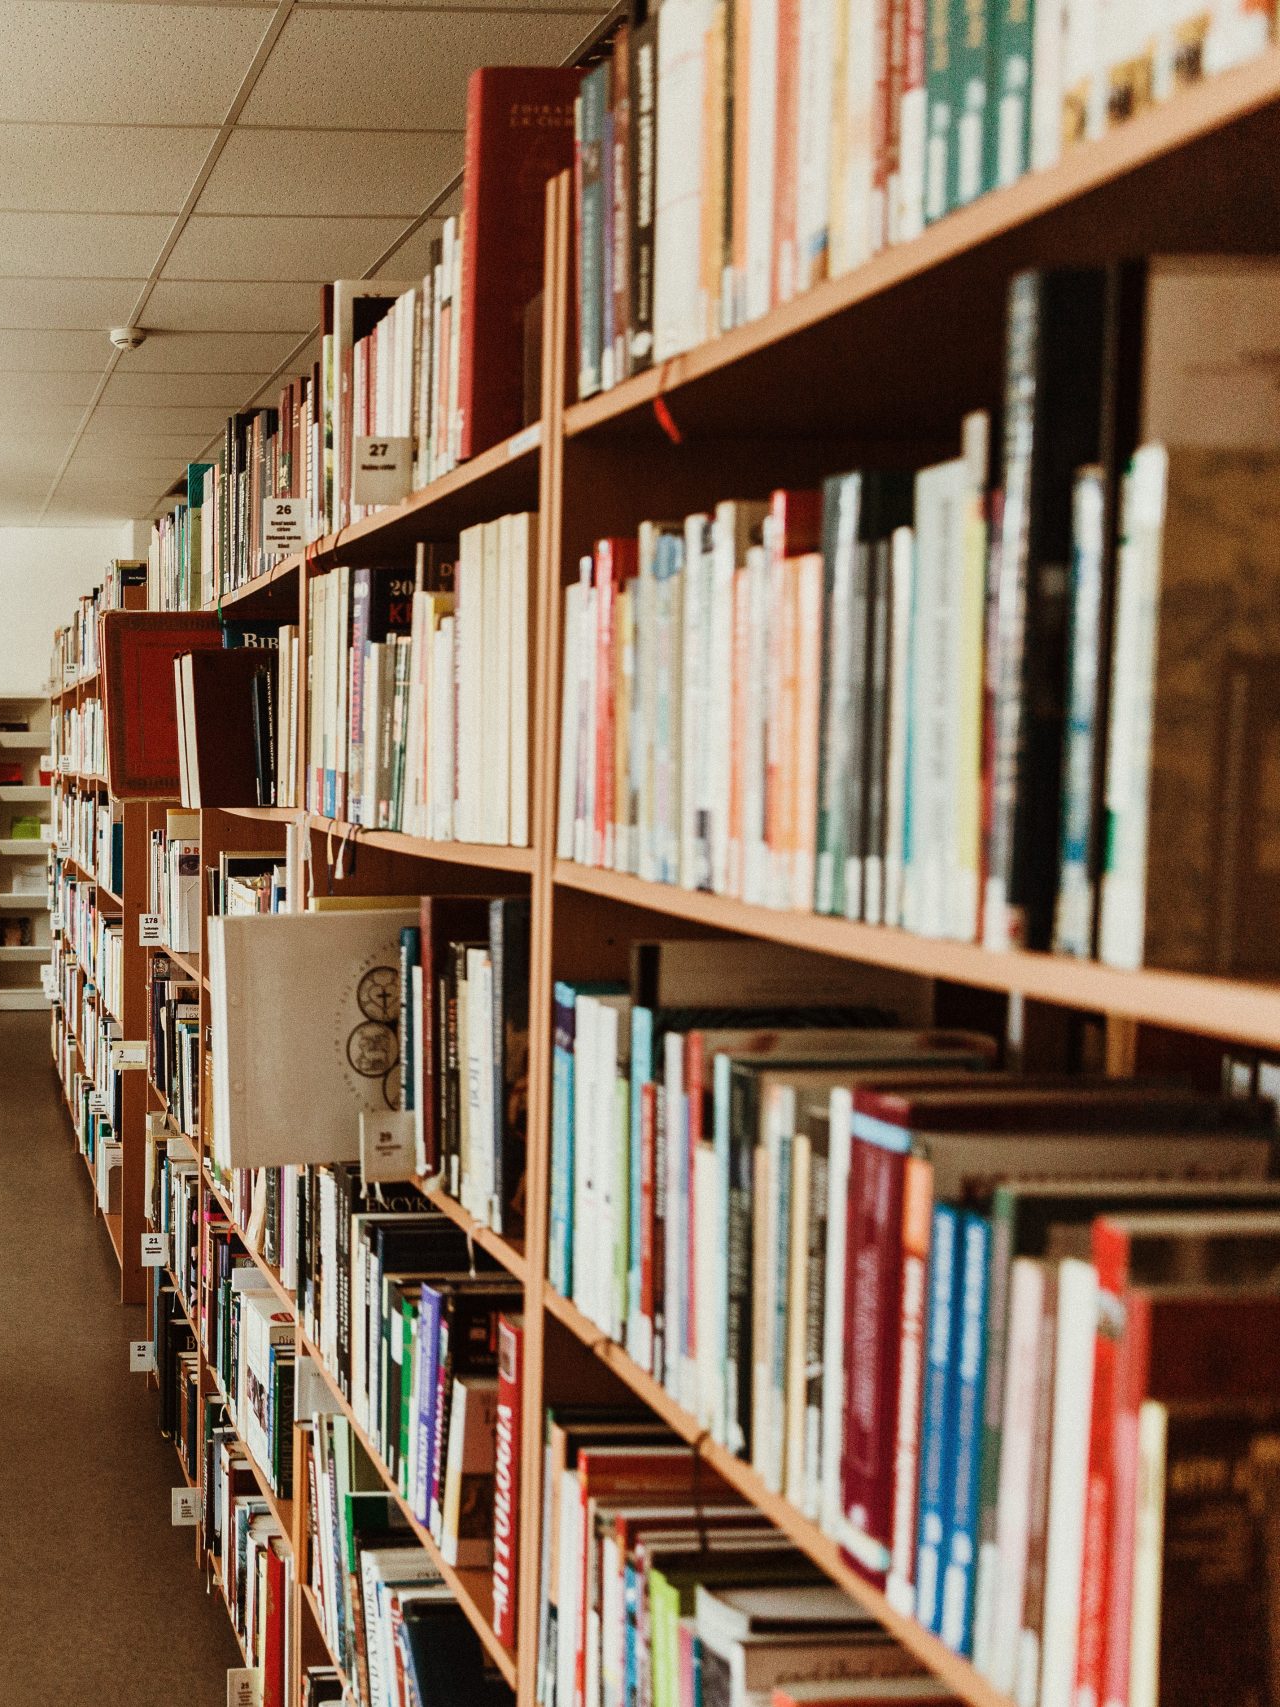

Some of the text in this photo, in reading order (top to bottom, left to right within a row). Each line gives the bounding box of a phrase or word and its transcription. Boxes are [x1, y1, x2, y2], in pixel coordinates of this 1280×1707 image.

[369, 443, 389, 457] 27
[276, 504, 292, 515] 26
[119, 1050, 124, 1058] 2
[137, 1344, 146, 1352] 22
